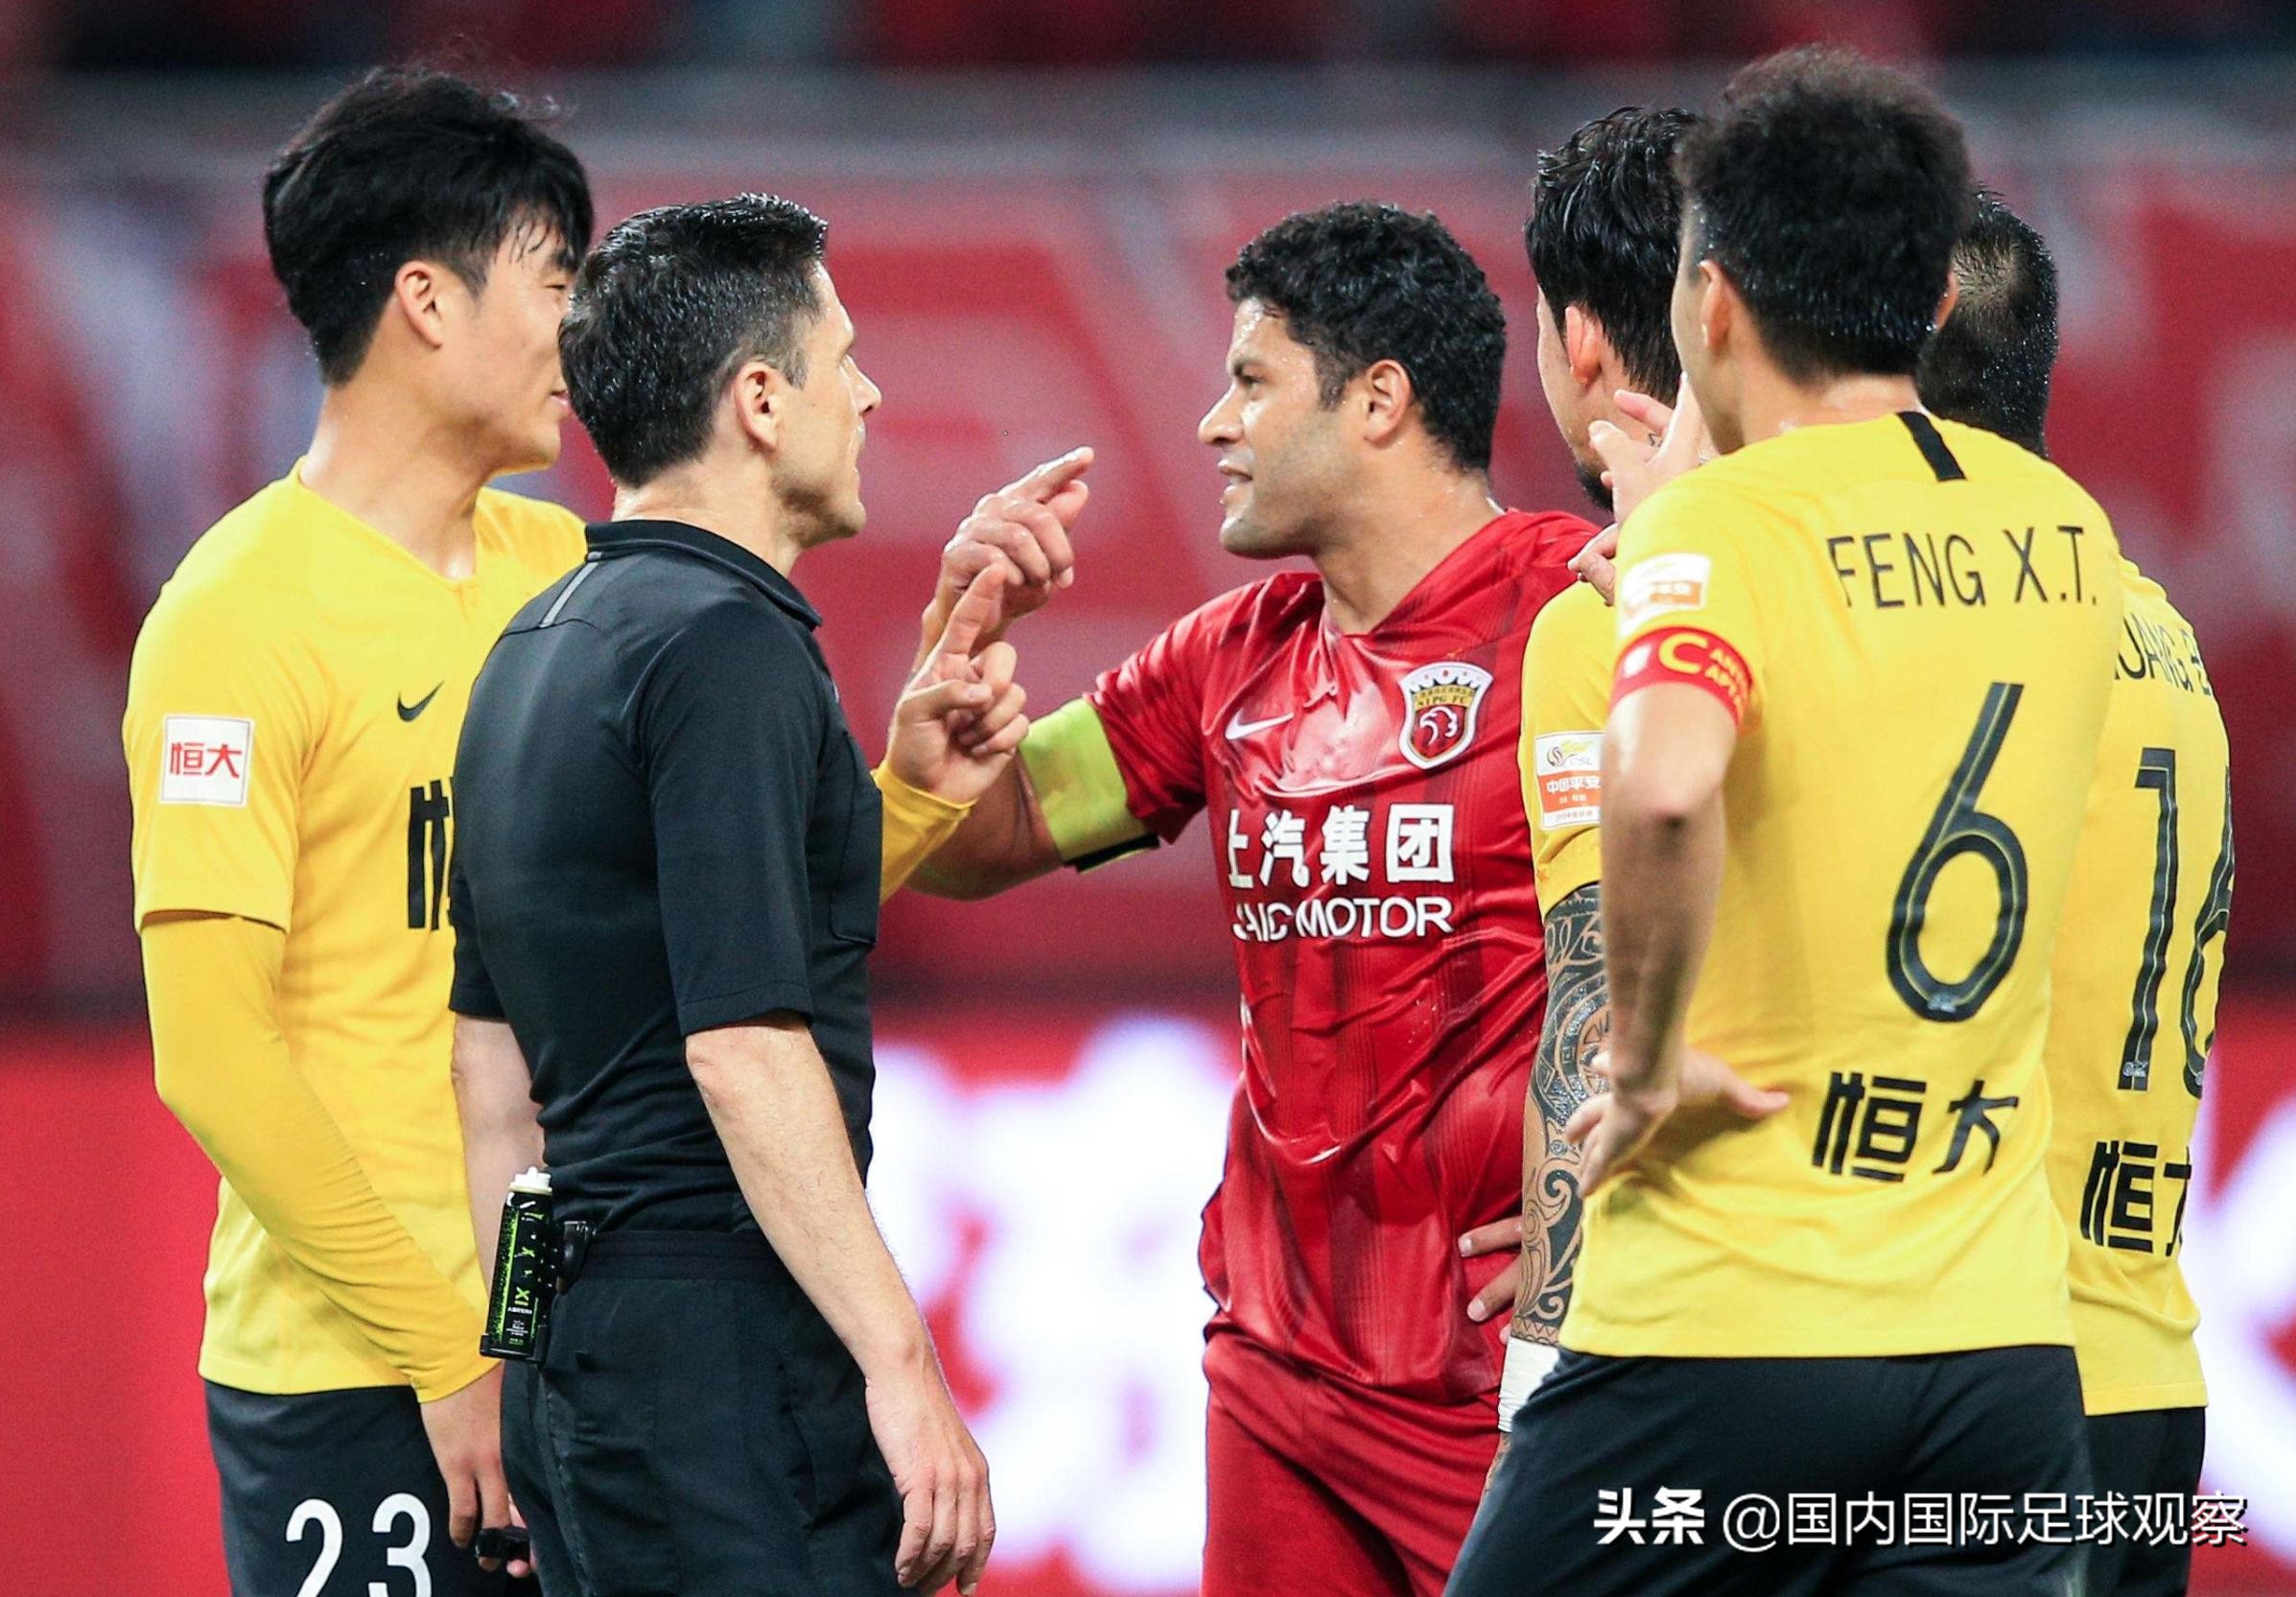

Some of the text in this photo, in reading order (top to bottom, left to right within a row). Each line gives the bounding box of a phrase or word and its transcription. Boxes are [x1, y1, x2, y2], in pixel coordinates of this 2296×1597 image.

[1826, 526, 2097, 608] FENG X.T.
[169, 741, 242, 779] 恒大
[1229, 804, 1454, 888] 上汽集团
[1886, 682, 2028, 1022] 6
[1296, 896, 1455, 938] MOTOR
[1813, 1070, 2019, 1183] 恒大
[285, 1492, 432, 1597] 23
